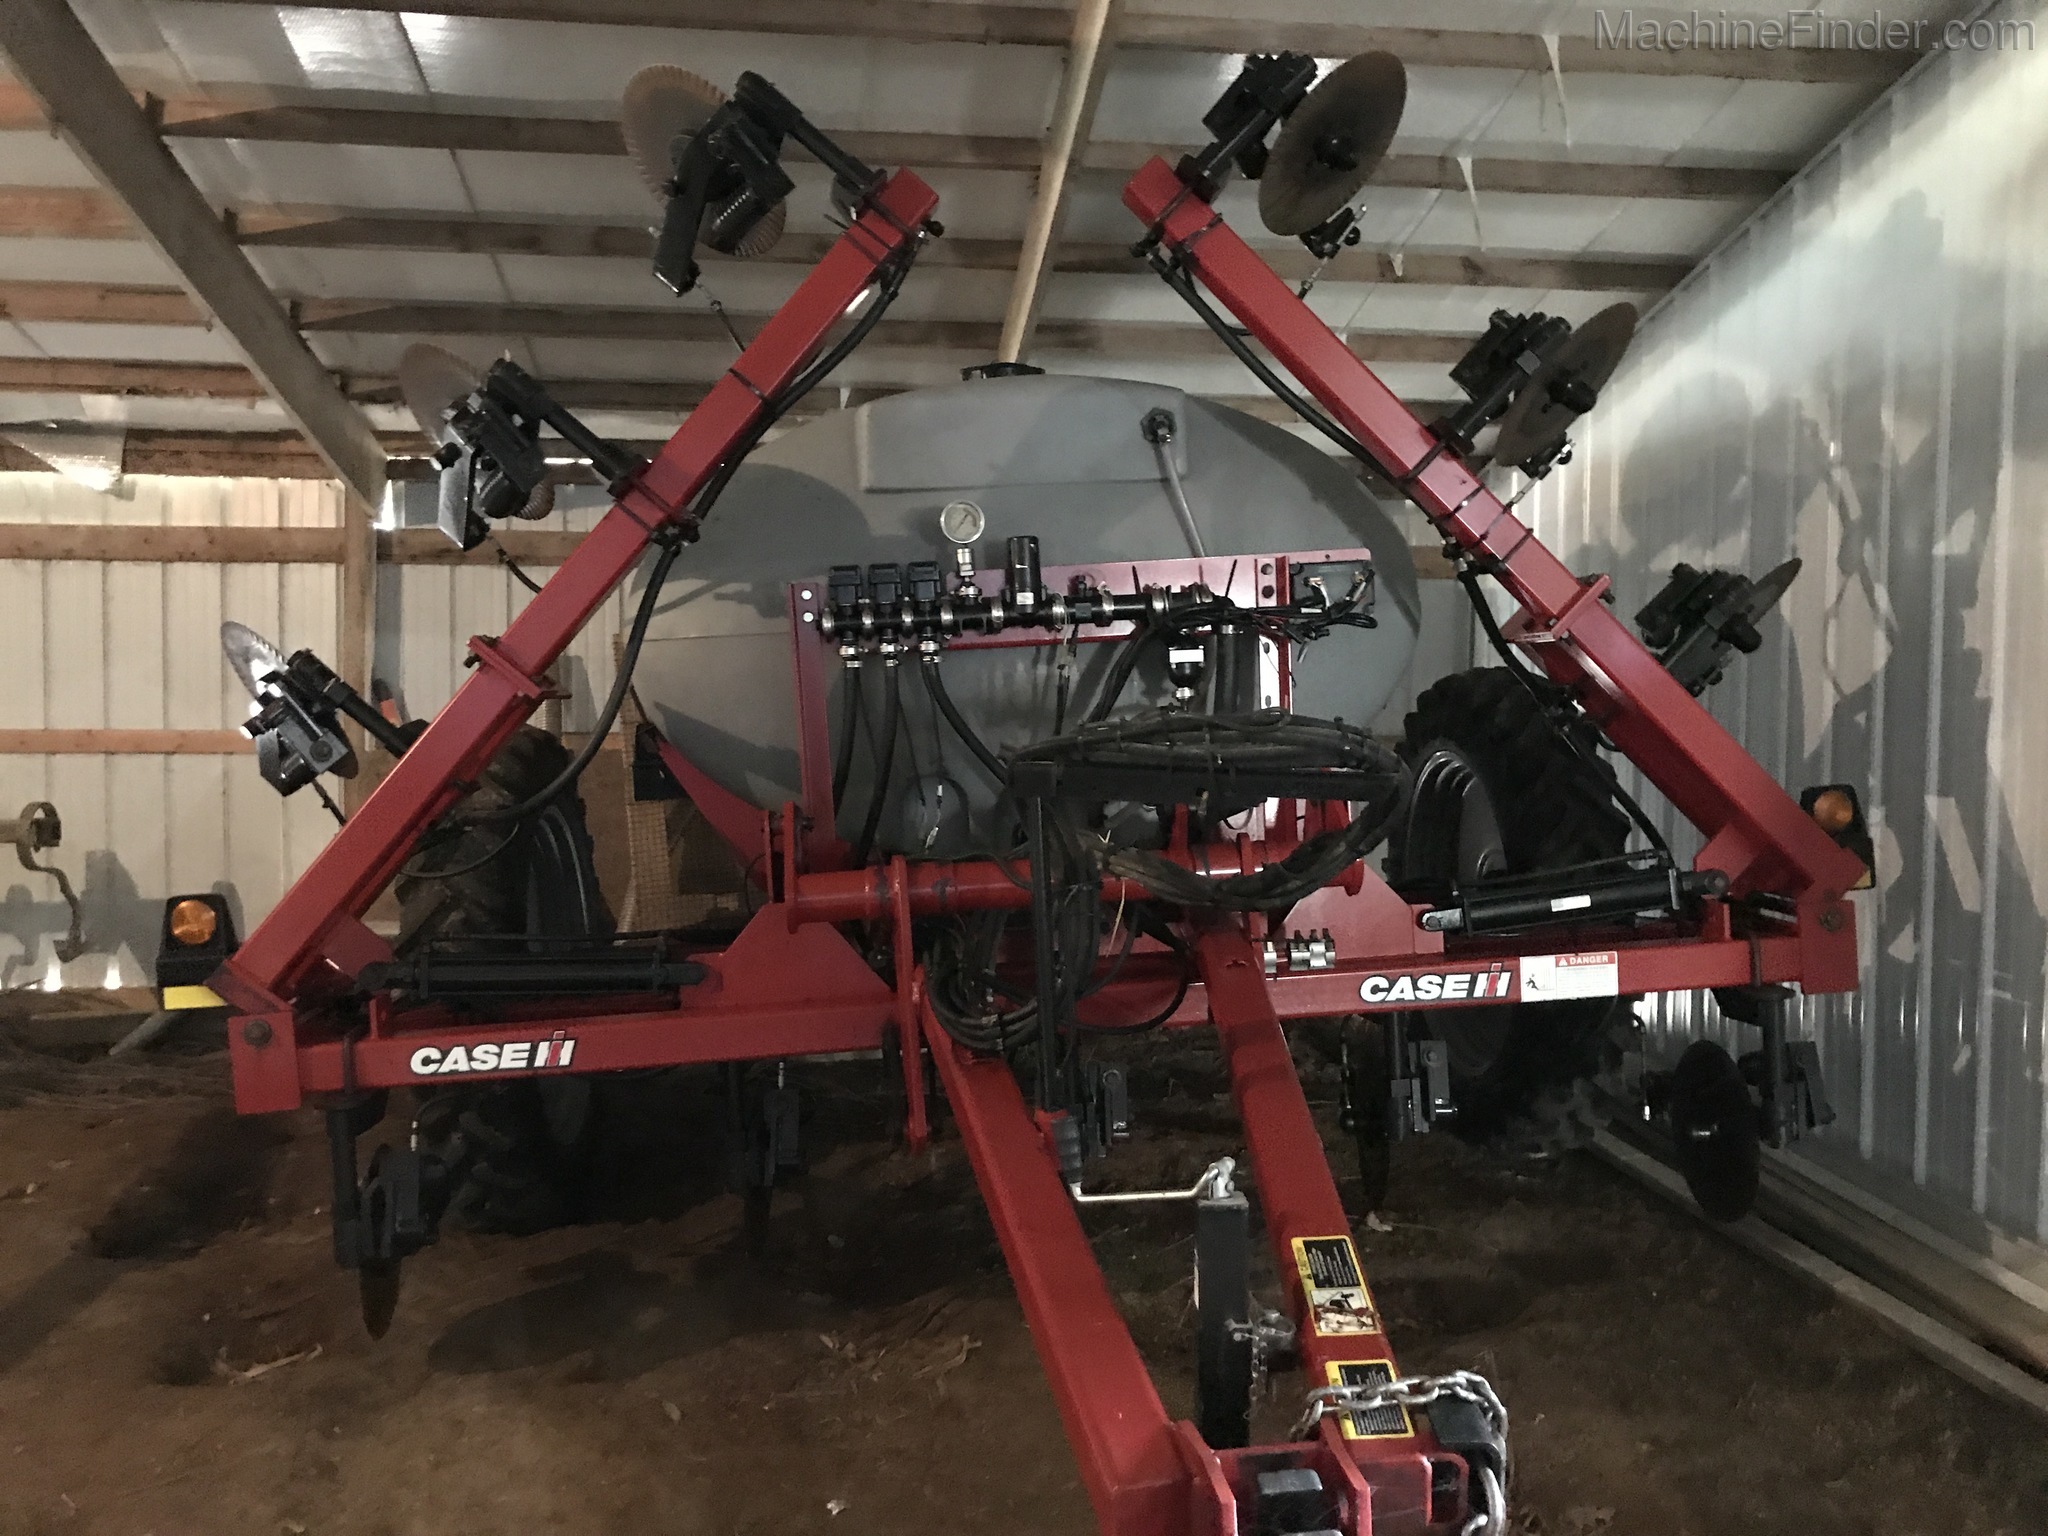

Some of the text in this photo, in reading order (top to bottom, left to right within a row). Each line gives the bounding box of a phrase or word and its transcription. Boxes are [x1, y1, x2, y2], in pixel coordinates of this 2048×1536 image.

[1570, 955, 1609, 965] DANGER
[1360, 974, 1471, 1002] CASE
[410, 1043, 532, 1075] CASE
